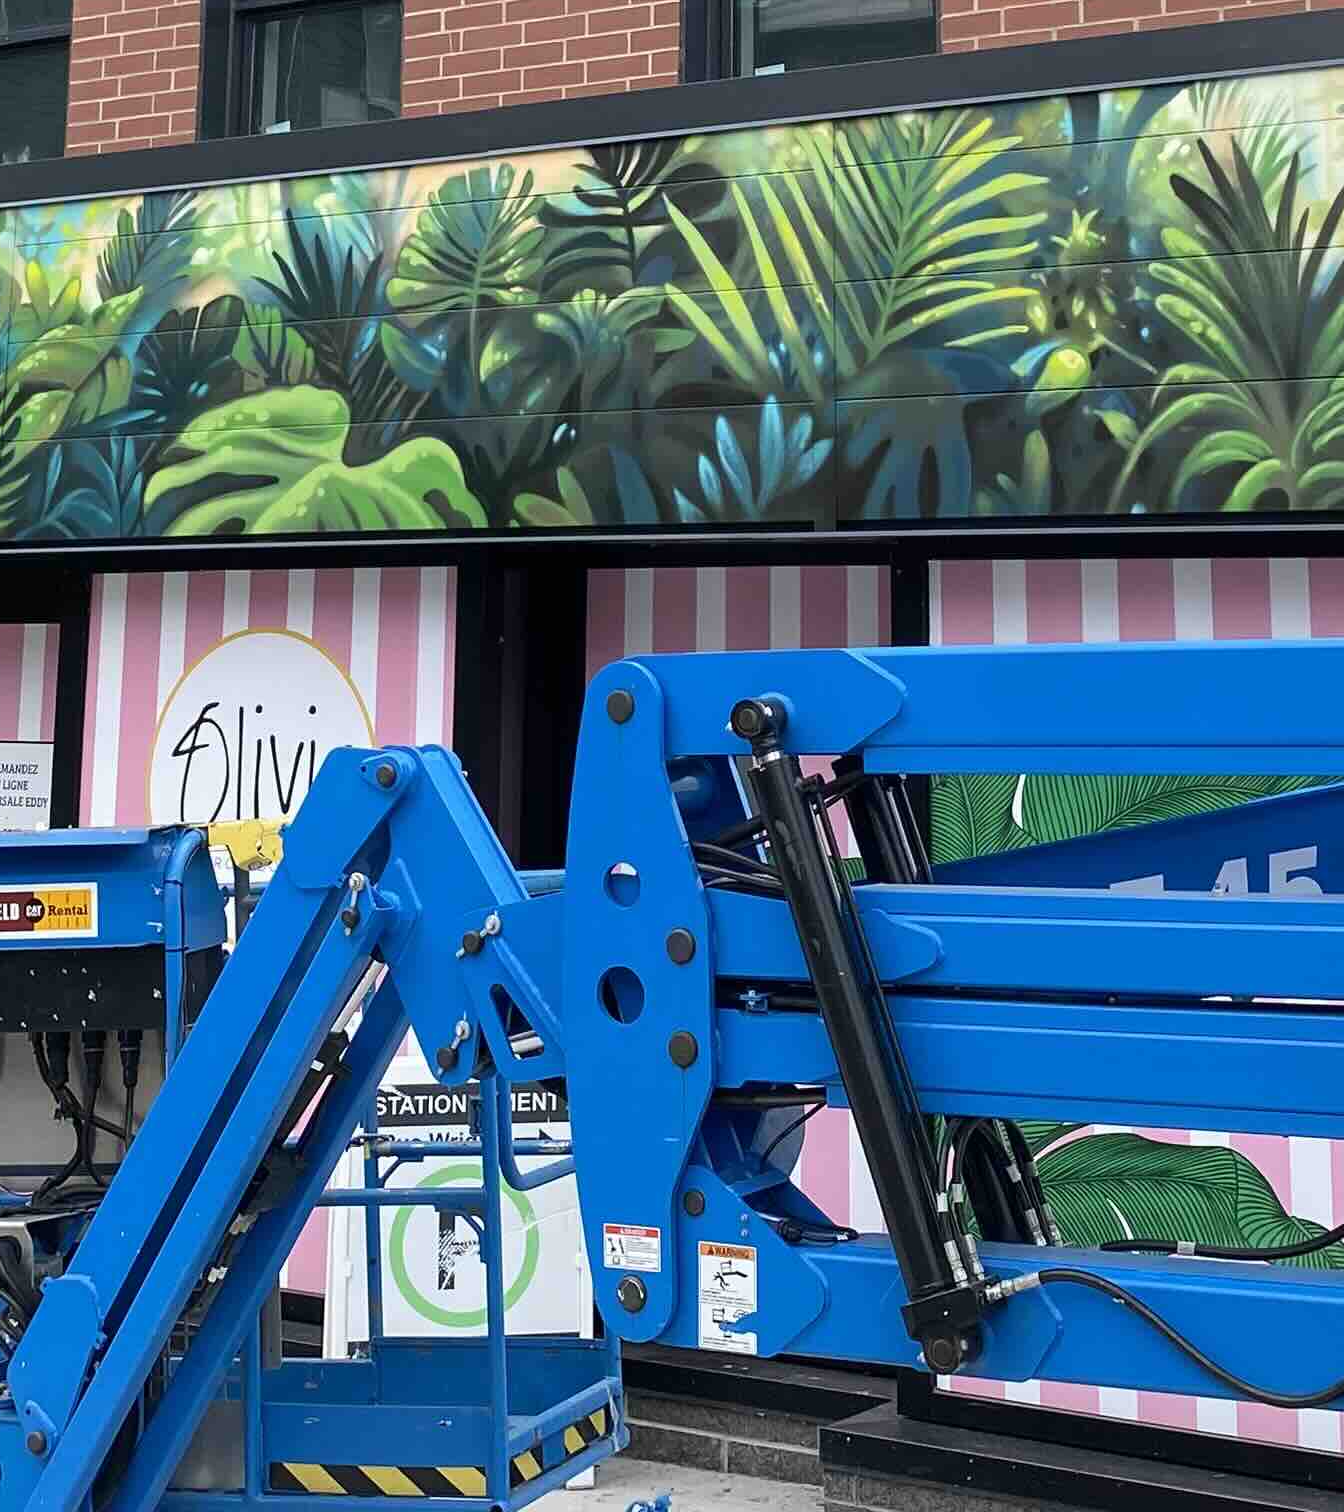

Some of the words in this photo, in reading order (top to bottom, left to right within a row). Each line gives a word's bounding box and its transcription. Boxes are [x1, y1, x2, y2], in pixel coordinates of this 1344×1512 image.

[172, 701, 317, 822] Olivi
[2, 779, 29, 791] LIGNE
[25, 796, 49, 809] EDDY
[25, 904, 43, 918] CAT
[47, 903, 88, 917] Rental
